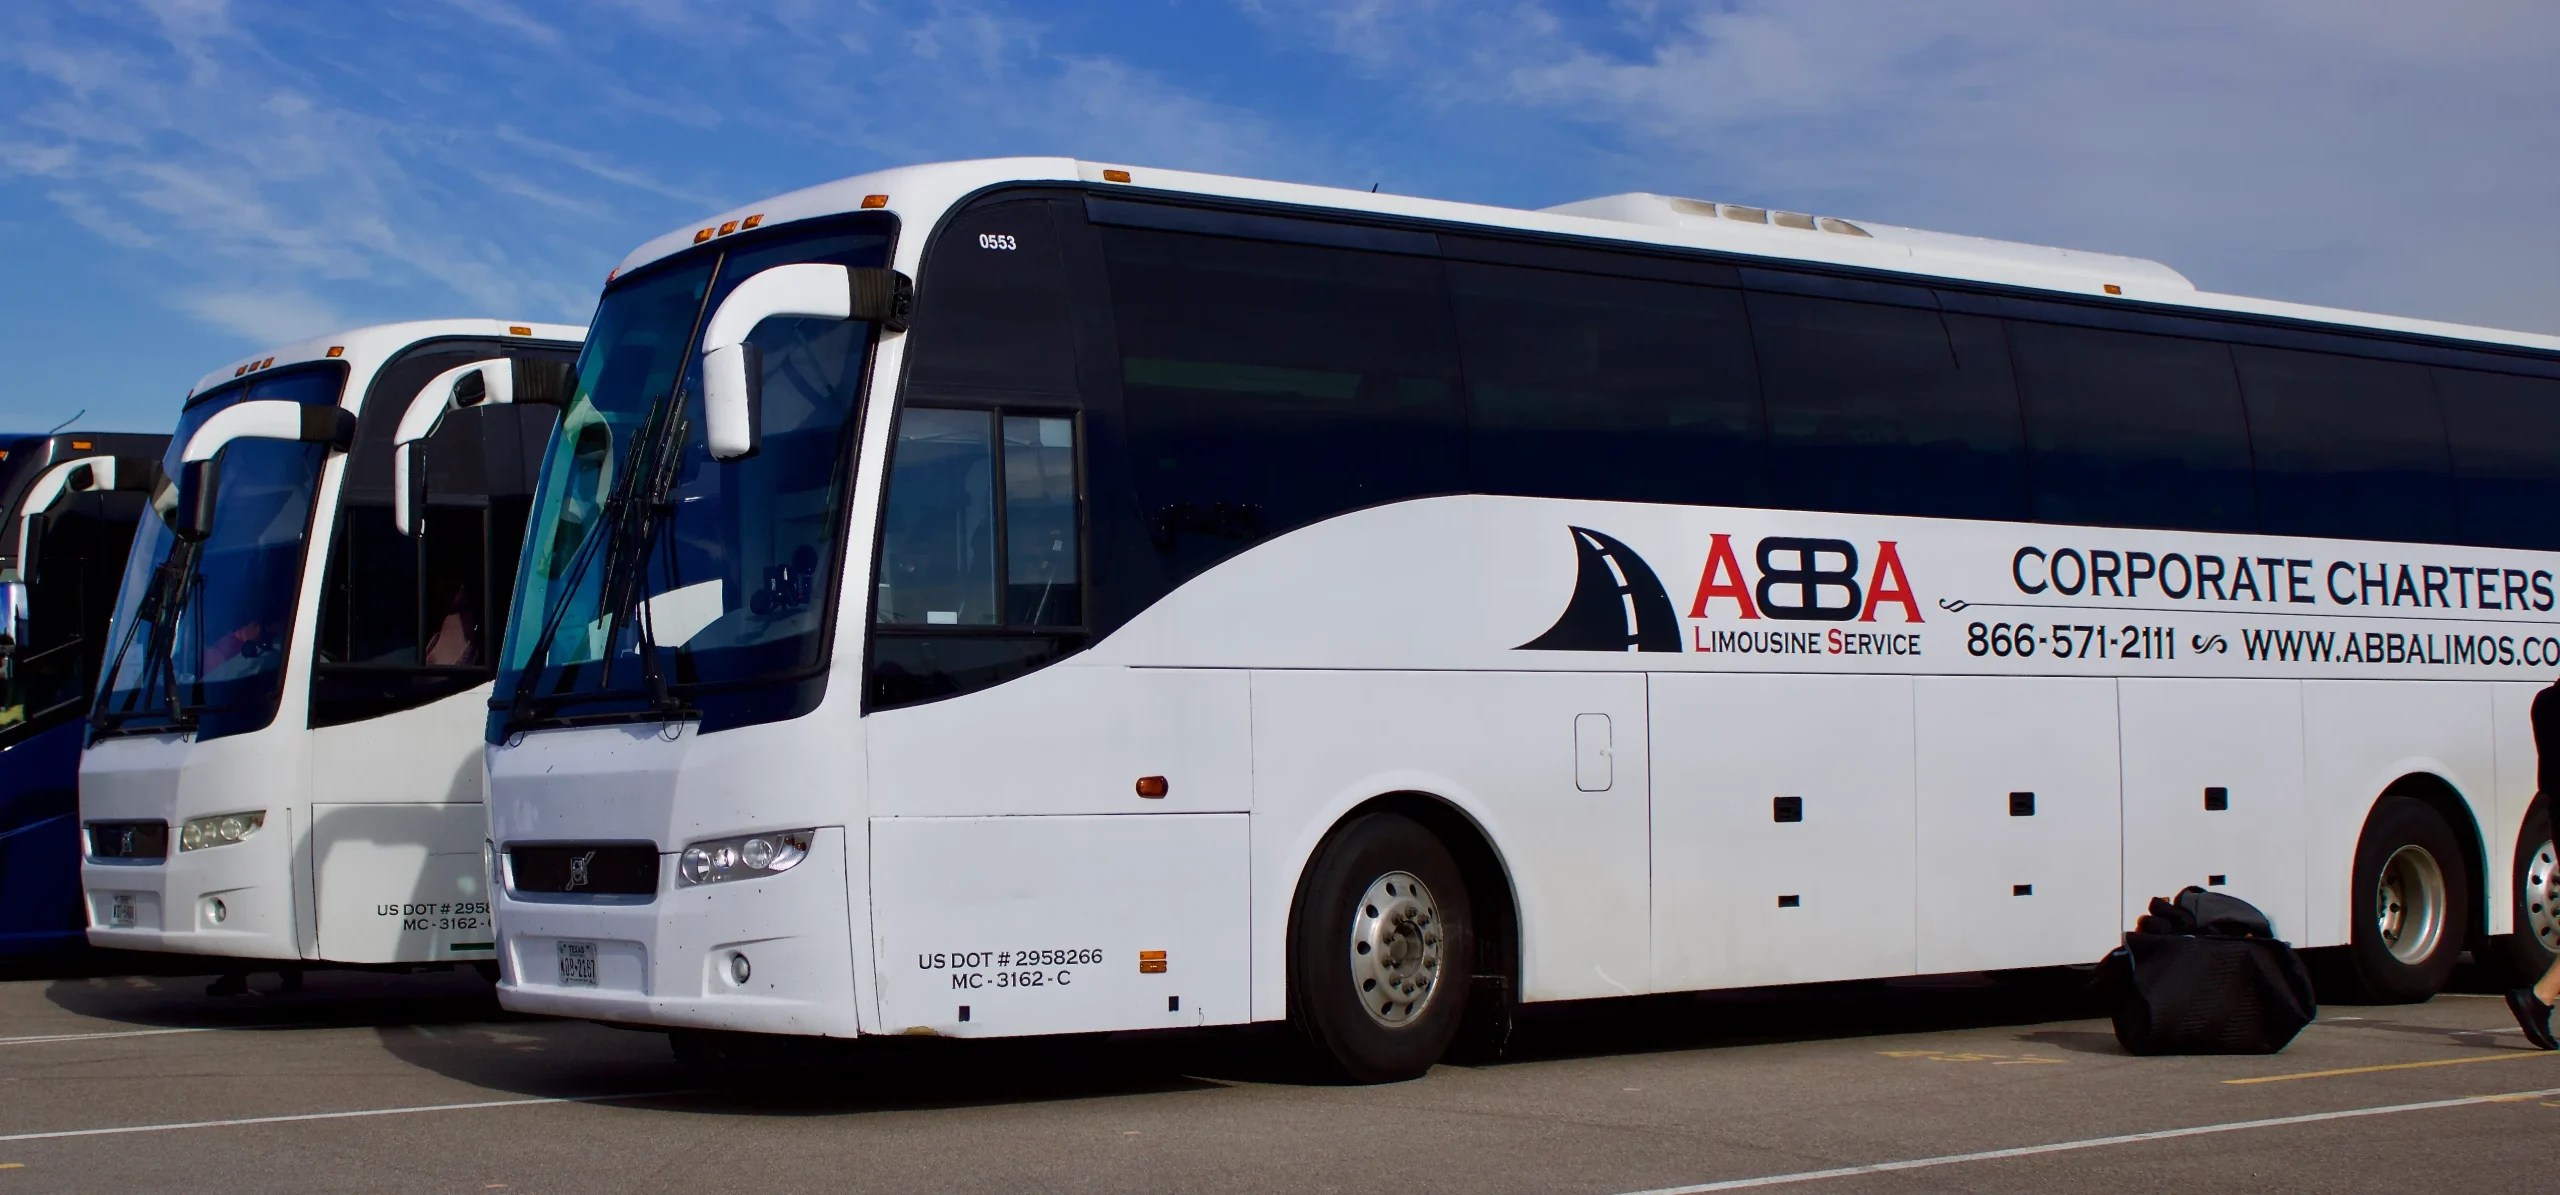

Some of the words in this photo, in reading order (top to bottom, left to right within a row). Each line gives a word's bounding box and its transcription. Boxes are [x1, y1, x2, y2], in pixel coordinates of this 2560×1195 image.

[979, 233, 1017, 250] 0553
[1688, 533, 1926, 623] ABBA
[2012, 545, 2316, 605] CORPORATE
[2327, 561, 2555, 612] CHARTERS
[1694, 625, 1821, 655] LIMOUSINE
[1827, 628, 1921, 656] SERVICE
[1966, 622, 2176, 661] 866-571-2111
[377, 904, 399, 916] US
[403, 904, 437, 916] DOT
[440, 904, 451, 915] #
[403, 919, 429, 931] MC
[439, 918, 477, 930] 3162
[918, 953, 946, 969] US
[951, 952, 993, 968] DOT
[997, 951, 1011, 967] #
[1015, 949, 1103, 967] 2958266
[952, 973, 983, 989] MC
[996, 971, 1044, 988] 3162
[1056, 970, 1071, 986] C
